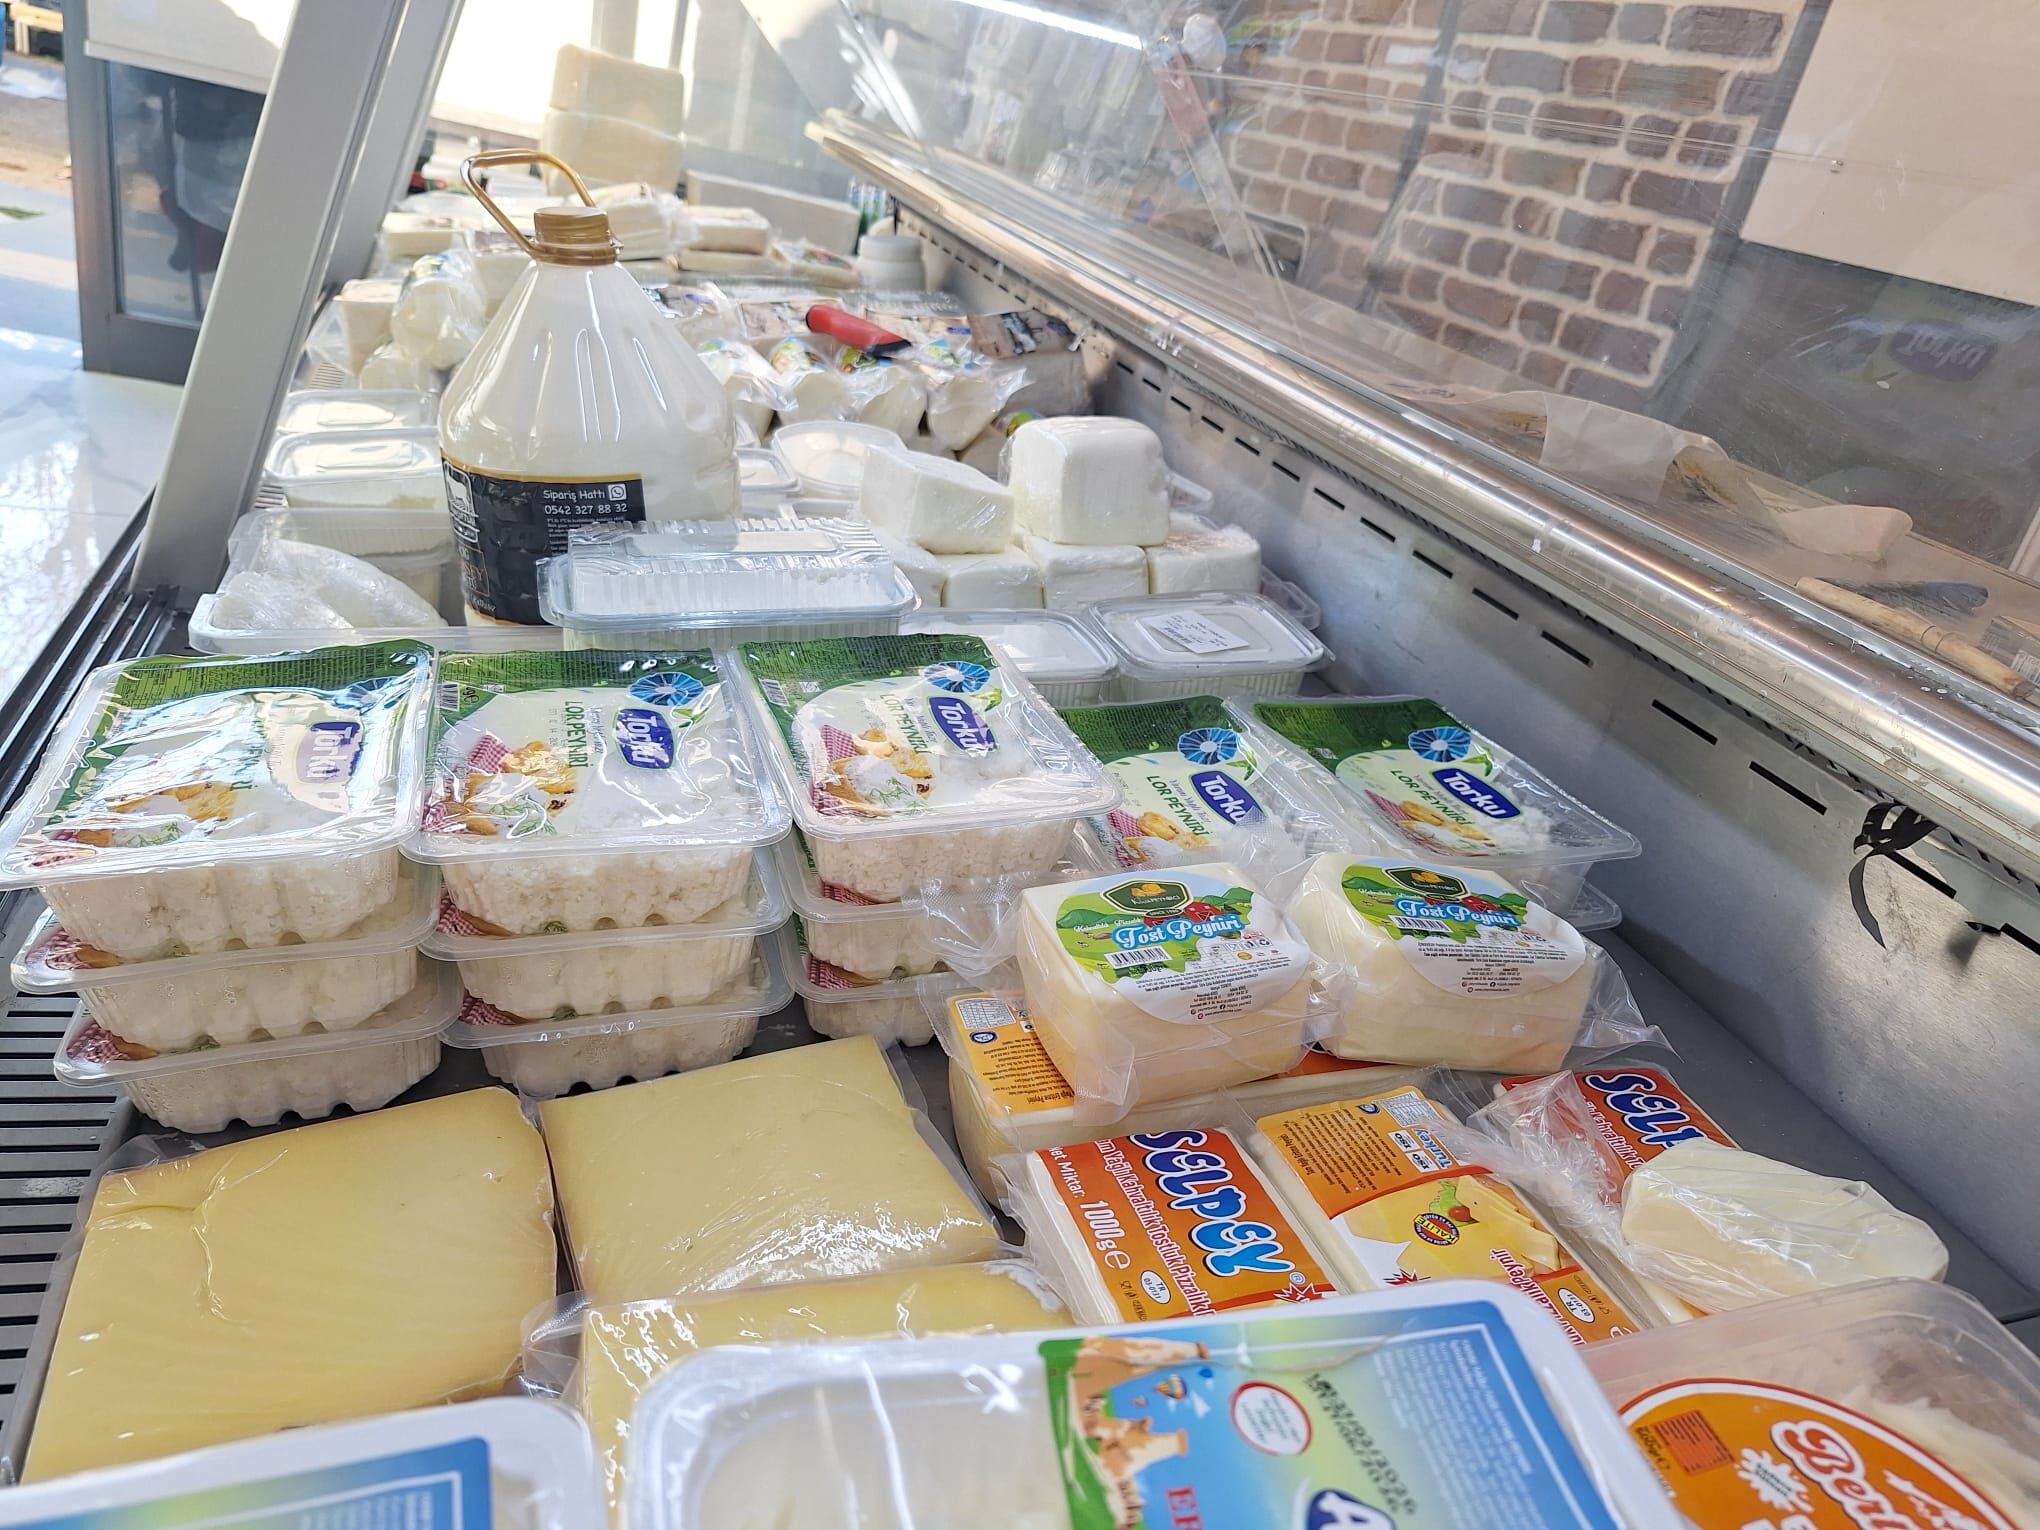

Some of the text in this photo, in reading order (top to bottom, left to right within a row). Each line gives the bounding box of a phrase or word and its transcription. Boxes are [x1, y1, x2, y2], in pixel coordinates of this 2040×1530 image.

[543, 489, 606, 503] Sipariş Hattı
[544, 503, 628, 515] 0542 327 88 32
[564, 701, 585, 723] LOR
[307, 726, 352, 778] Torku
[1146, 775, 1172, 797] LOR
[1390, 770, 1420, 789] LOR
[1200, 775, 1246, 822] Torku
[1444, 772, 1507, 816] Torku
[1397, 899, 1517, 926] Tost Peyniri
[1115, 914, 1242, 949] Tost Peyniri
[1395, 1132, 1411, 1149] ISO
[1414, 1128, 1453, 1169] Turkey
[1412, 1153, 1430, 1170] ISO
[1057, 1160, 1086, 1199] Miktar:
[1147, 1224, 1187, 1272] Tostluk
[1489, 1248, 1526, 1285] Peynir
[1156, 1281, 1166, 1292] TR
[1566, 1299, 1578, 1313] TR
